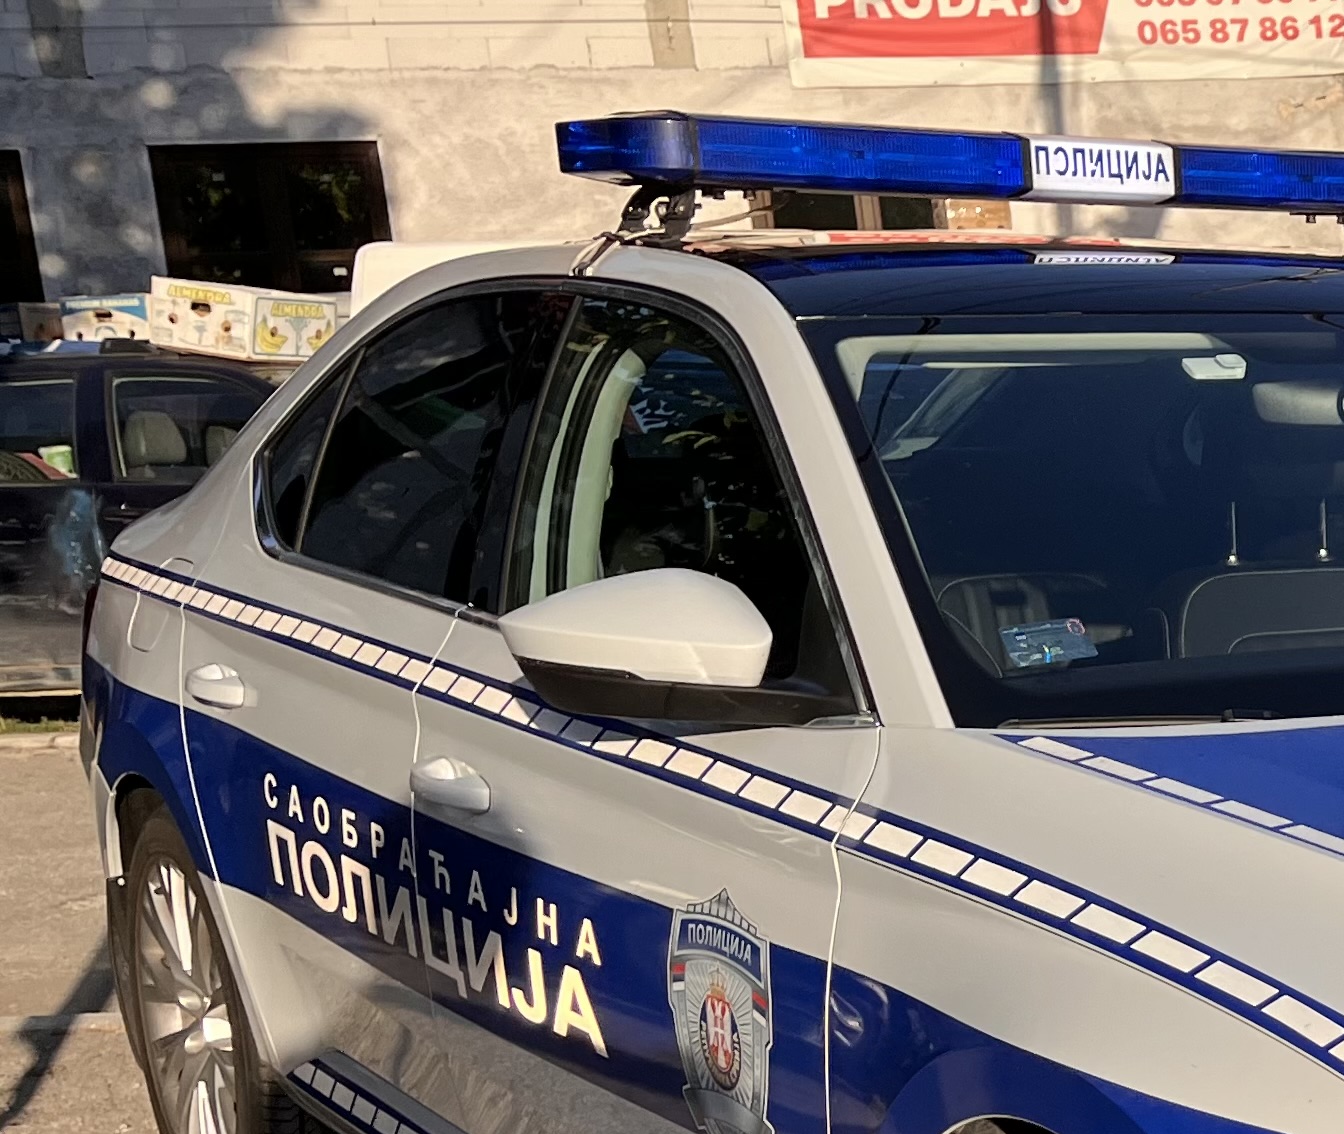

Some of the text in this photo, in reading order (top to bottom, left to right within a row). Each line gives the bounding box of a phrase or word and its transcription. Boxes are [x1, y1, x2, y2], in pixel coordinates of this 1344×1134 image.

[1137, 19, 1201, 45] 065
[1209, 18, 1249, 43] 87
[1258, 16, 1300, 41] 86
[167, 284, 232, 305] ALMENDRA
[271, 302, 326, 320] ALMENDRA
[262, 772, 602, 967] САОБРАЋАЈНА
[266, 819, 610, 1058] ПОЛИЦИЈА
[687, 923, 752, 967] ПОЛИЦИЈА
